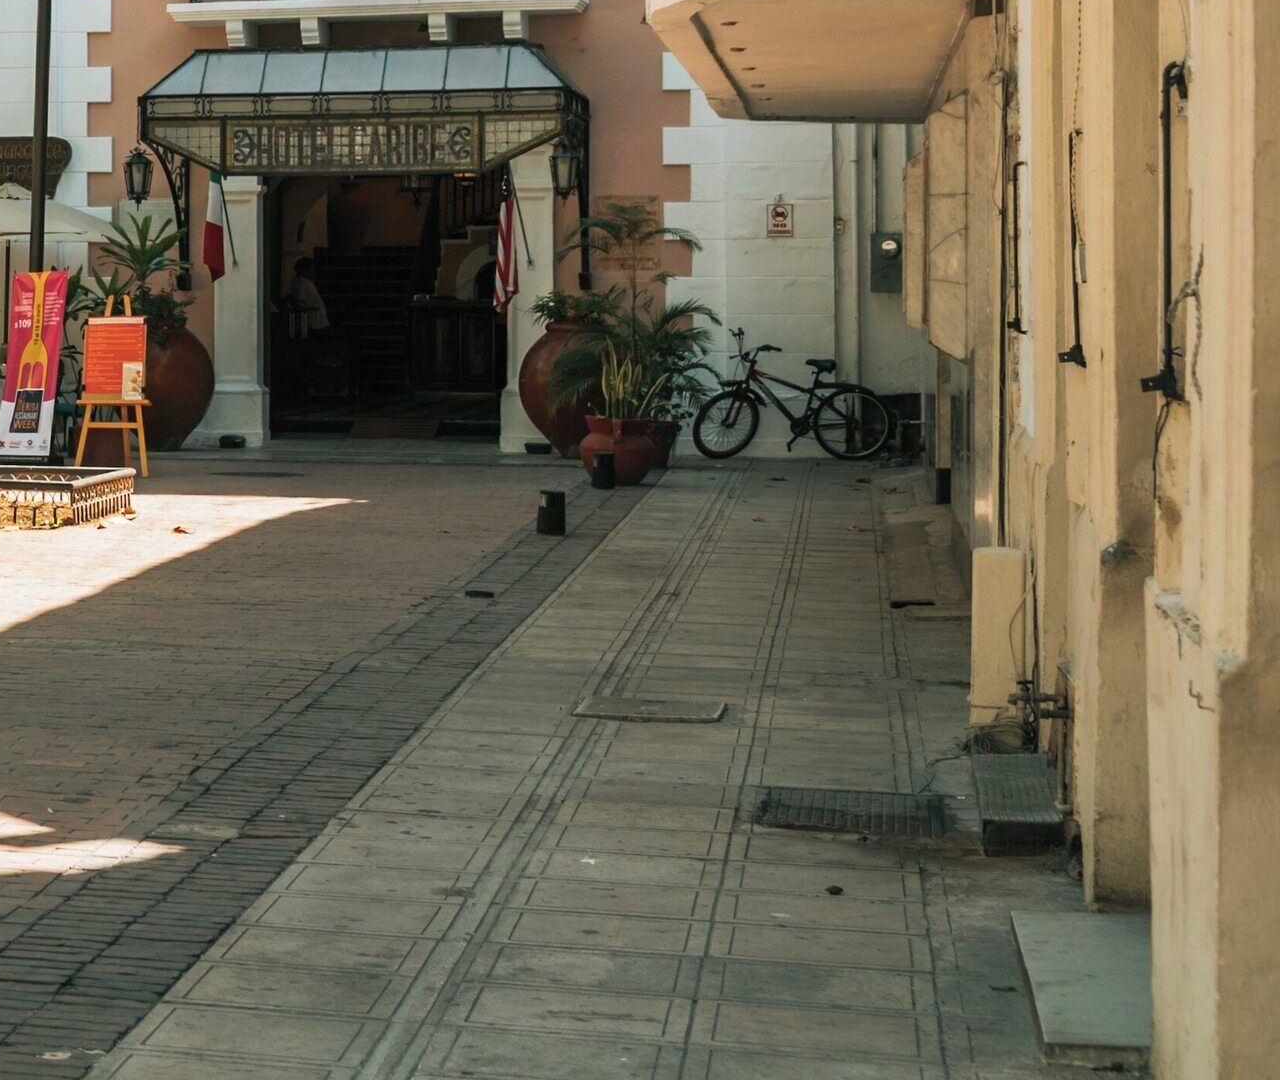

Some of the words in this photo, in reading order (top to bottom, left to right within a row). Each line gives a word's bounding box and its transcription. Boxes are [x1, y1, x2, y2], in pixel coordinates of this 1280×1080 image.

[256, 123, 333, 167] HOTEL
[347, 122, 447, 166] CARIBE
[13, 420, 37, 429] WEEK
